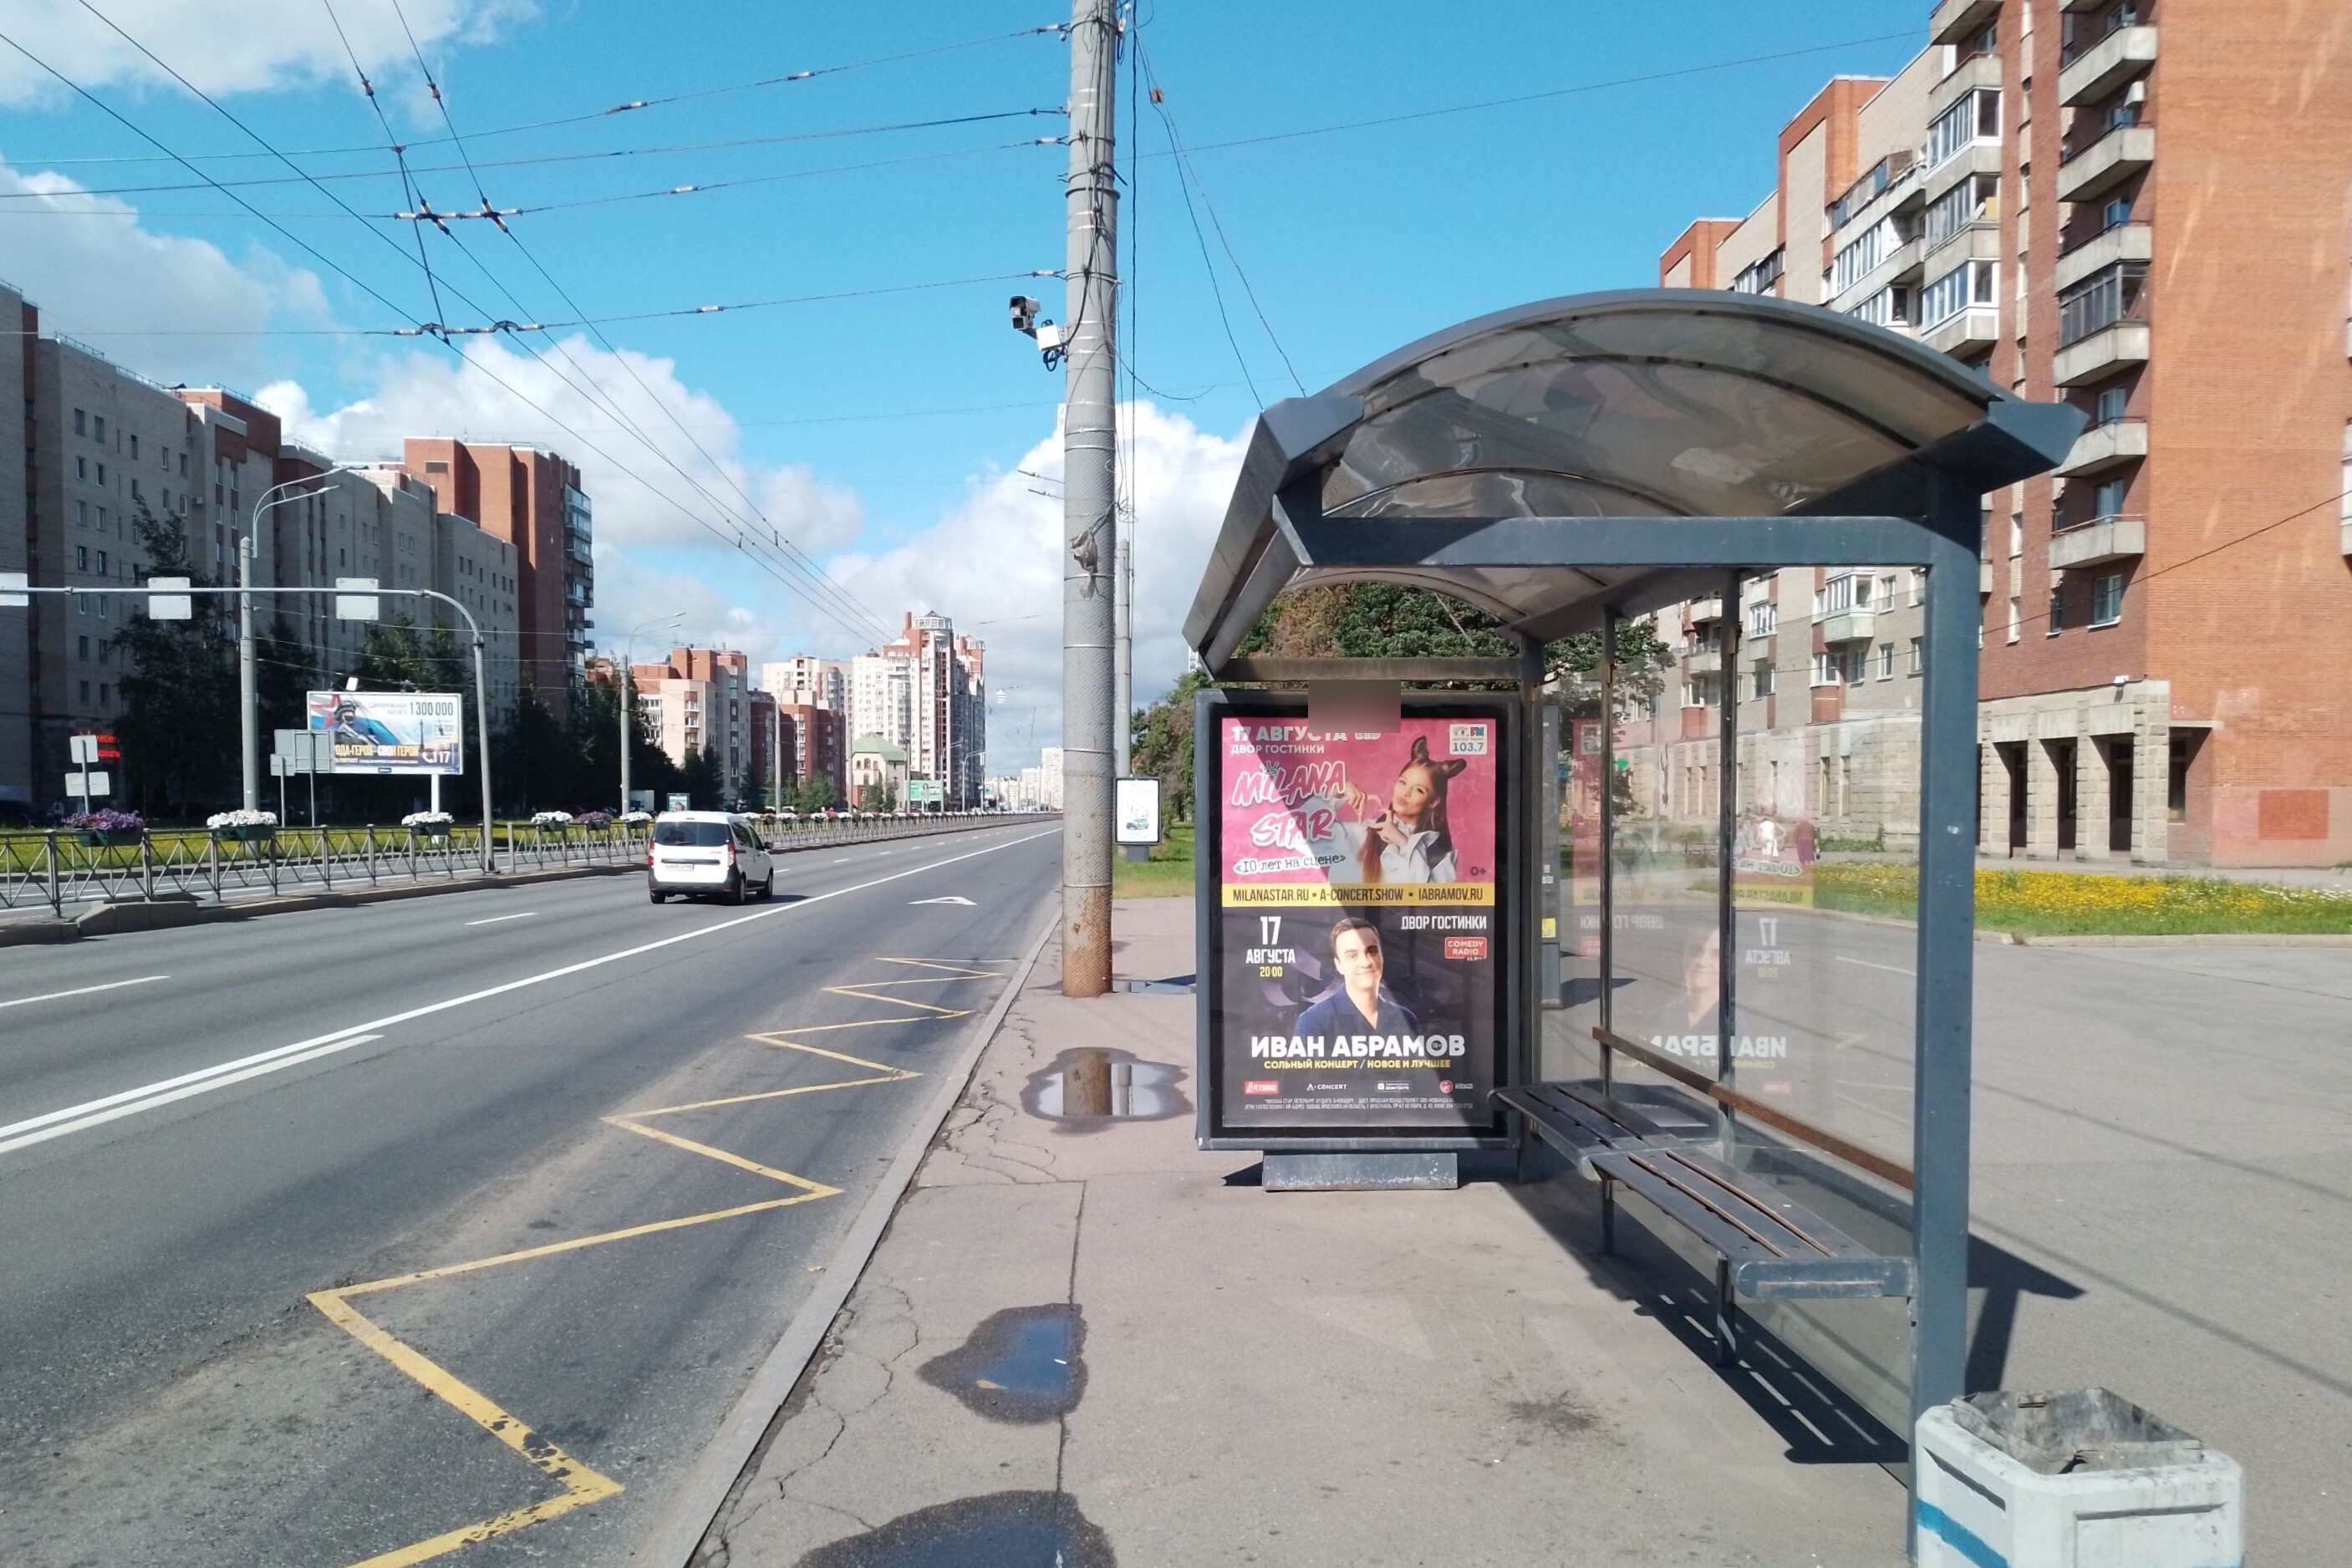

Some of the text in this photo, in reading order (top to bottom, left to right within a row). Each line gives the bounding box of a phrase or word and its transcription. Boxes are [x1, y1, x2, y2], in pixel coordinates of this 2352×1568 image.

[1231, 725, 1251, 741] 17
[1230, 744, 1325, 755] ДВОР ГОСТИНКИ
[1453, 742, 1484, 752] 103.7
[433, 751, 451, 763] 117
[1231, 761, 1347, 807] MILANA
[1250, 808, 1336, 850] STAR
[1260, 860, 1281, 871] лет
[1285, 858, 1300, 868] на
[1303, 854, 1347, 868] сцене»
[1470, 866, 1487, 877] 0+
[1233, 887, 1484, 902] MILANASTAR.RU A-CONCERT.SHOW IABRAMOV.RU
[1401, 915, 1487, 930] ДВОР ГОСТИНКИ
[1260, 916, 1281, 945] 17
[1245, 948, 1296, 964] АВГУСТА
[1251, 1036, 1465, 1058] ИВАН АБРАМОВ
[1264, 1059, 1312, 1070] СОЛЬНЫЙ
[1315, 1060, 1358, 1070] КОНЦЕРТ
[1367, 1060, 1401, 1069] НОВОЕ
[1403, 1060, 1410, 1068] И
[1411, 1060, 1451, 1069] ЛУЧШЕЕ
